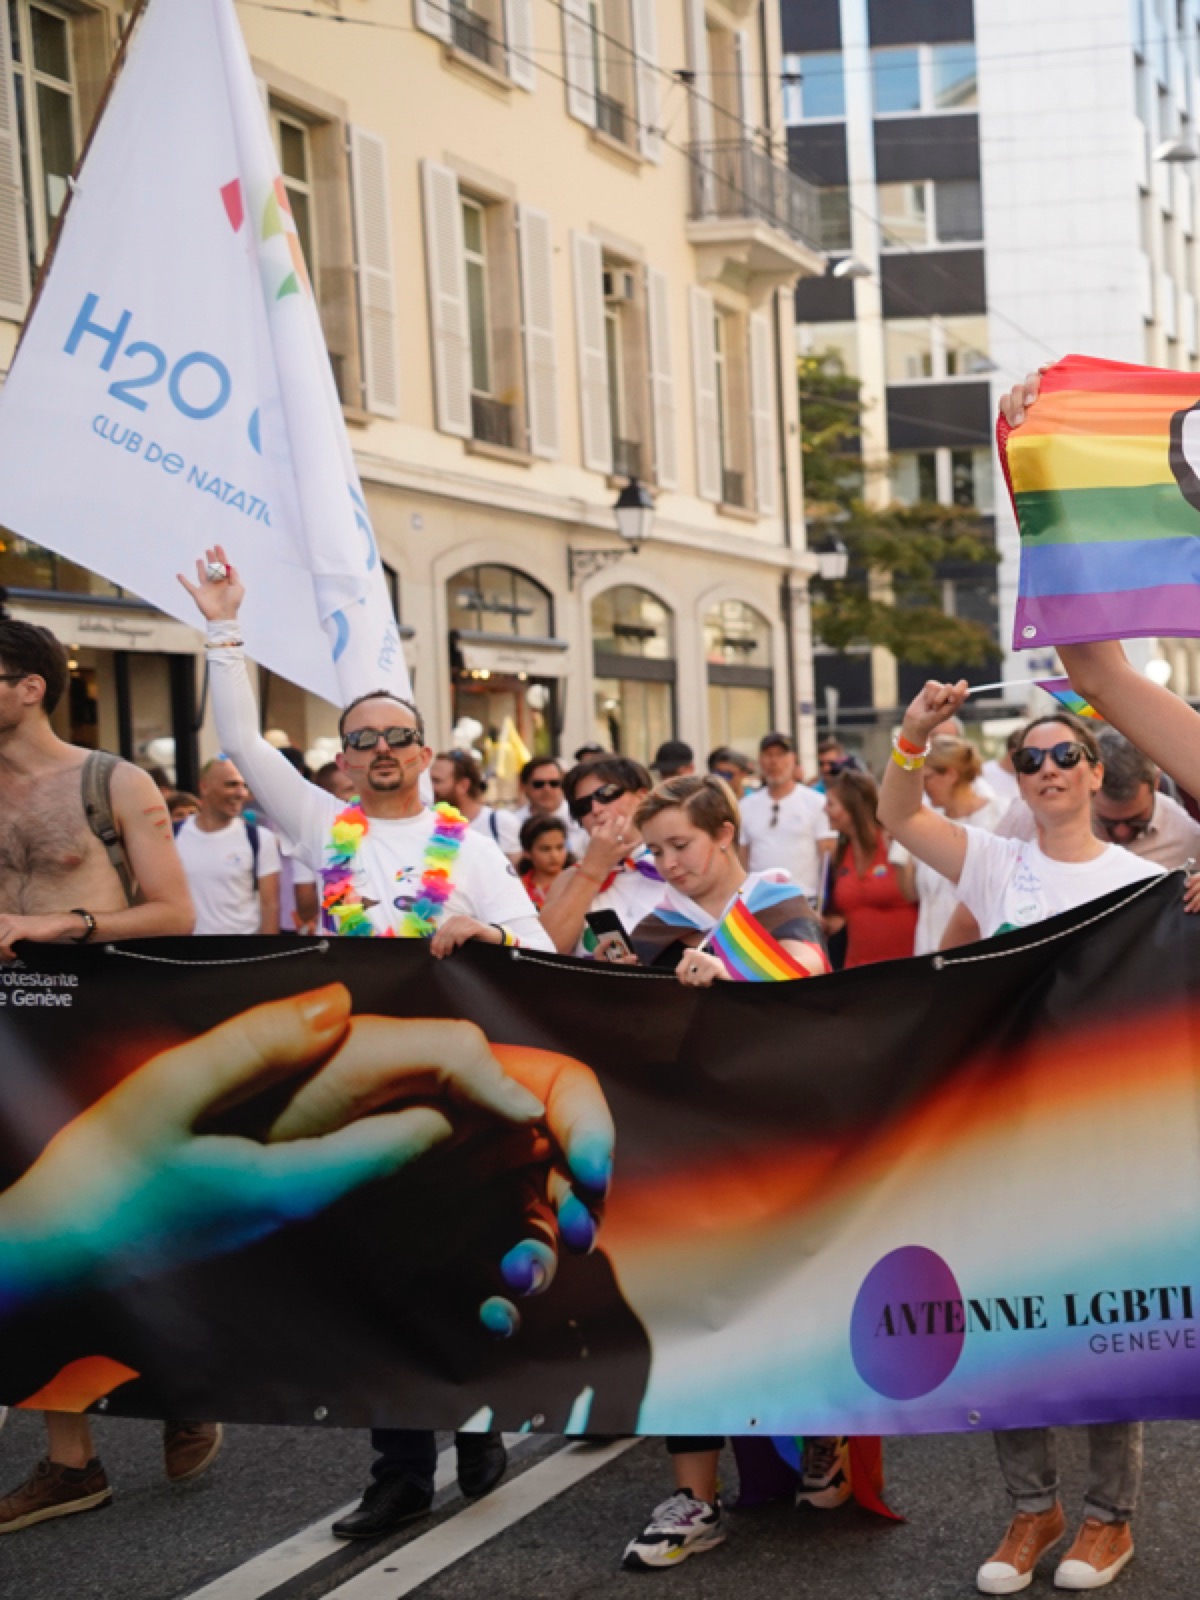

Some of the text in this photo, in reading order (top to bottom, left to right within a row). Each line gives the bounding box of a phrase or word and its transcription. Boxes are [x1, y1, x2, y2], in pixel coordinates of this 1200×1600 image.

[62, 292, 232, 420] H2O
[92, 413, 143, 453] CLUB
[12, 988, 72, 1007] Genève
[874, 1285, 1195, 1337] ANTENNE LGBTI
[1089, 1328, 1197, 1355] GENEVE
